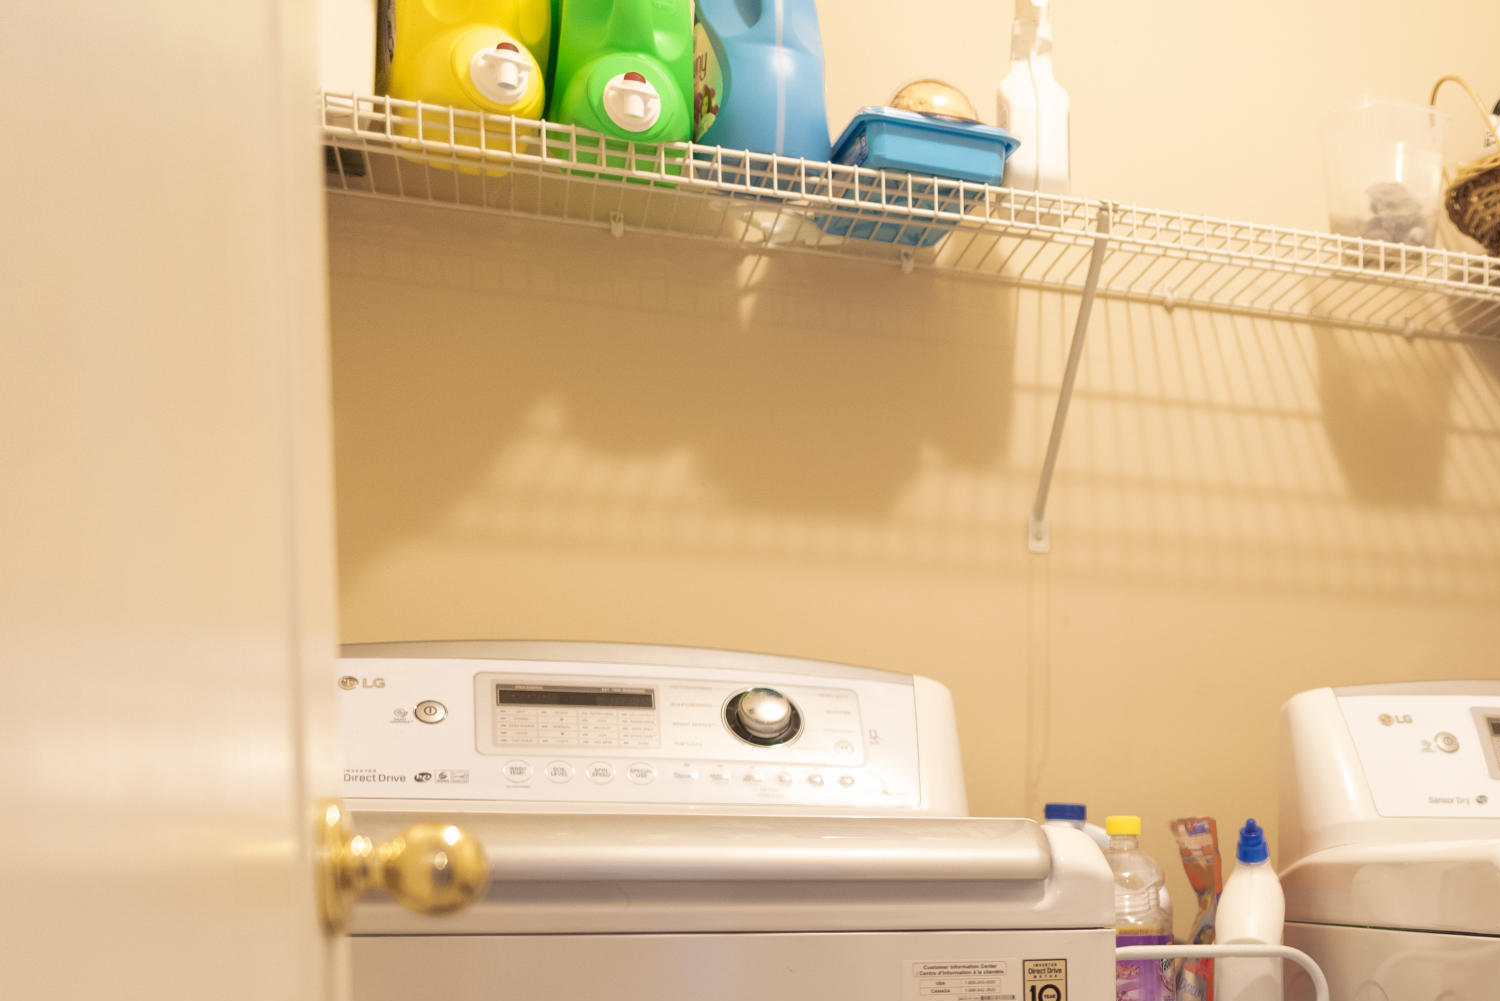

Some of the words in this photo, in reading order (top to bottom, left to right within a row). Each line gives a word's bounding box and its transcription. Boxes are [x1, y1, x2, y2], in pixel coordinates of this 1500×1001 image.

[362, 677, 386, 689] LG
[1394, 714, 1414, 725] LG
[343, 773, 376, 783] Direct
[378, 773, 407, 783] Drive
[1028, 967, 1046, 975] Direct
